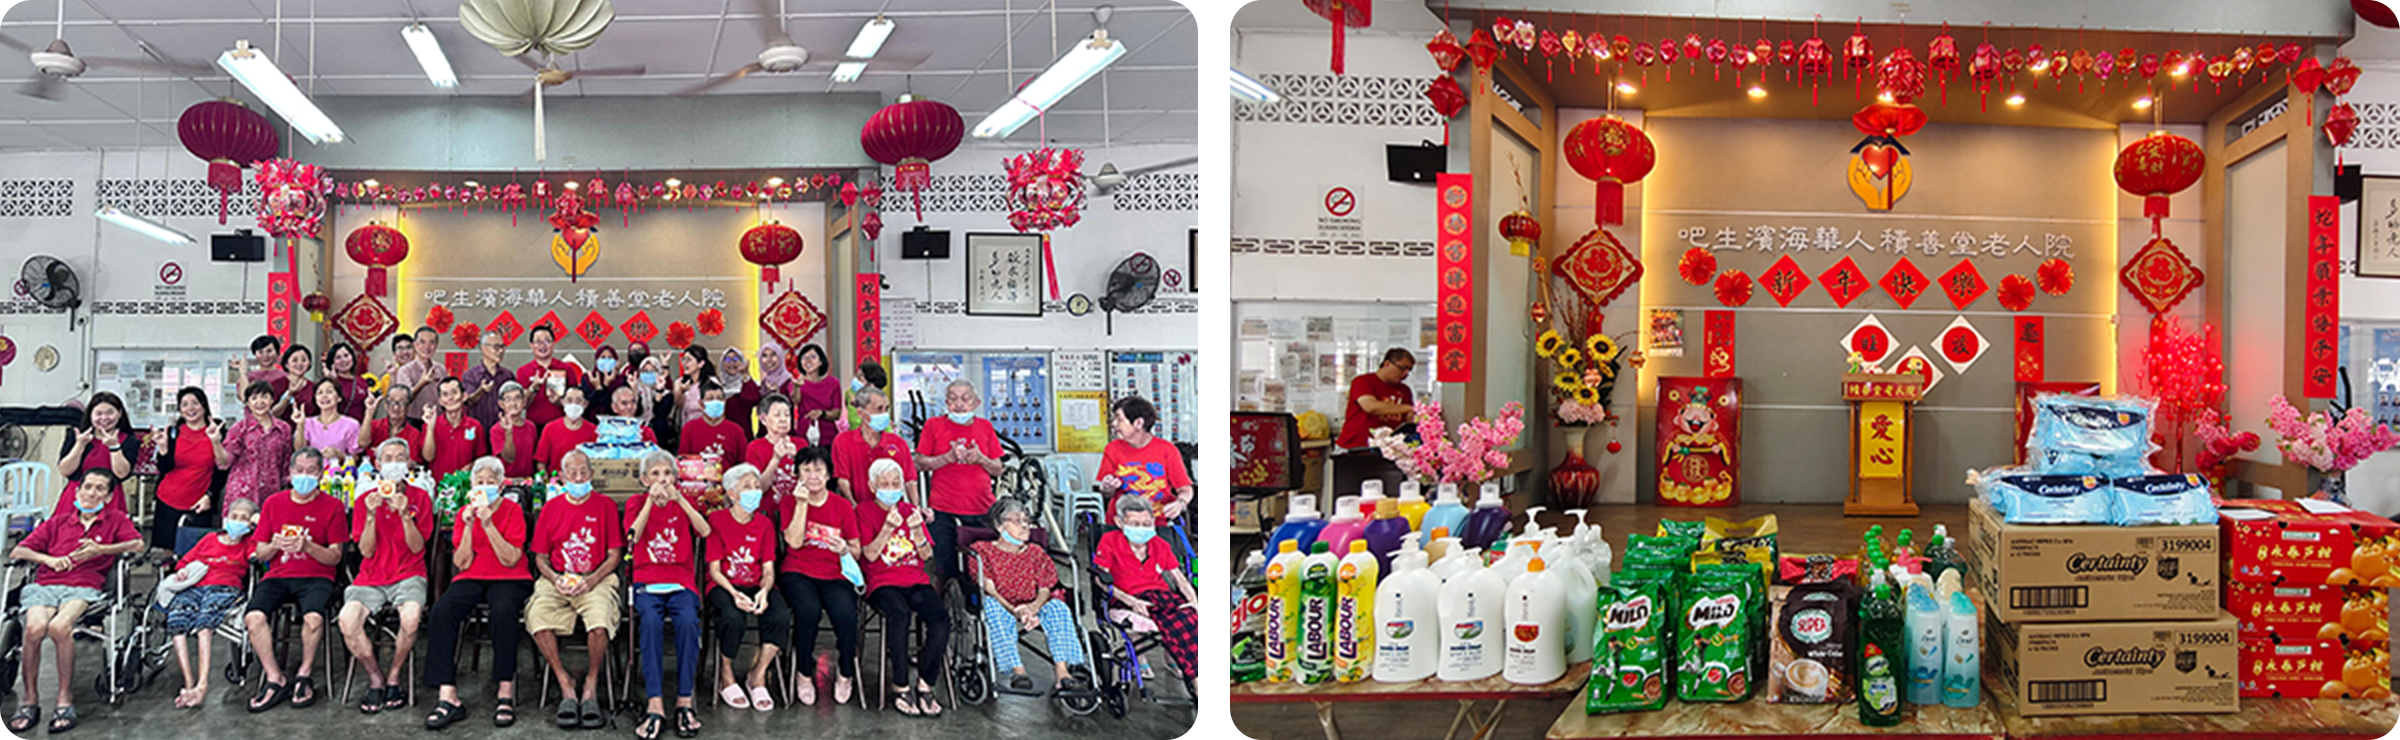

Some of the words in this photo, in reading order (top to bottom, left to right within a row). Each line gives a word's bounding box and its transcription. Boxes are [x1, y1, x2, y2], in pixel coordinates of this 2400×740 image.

[1678, 225, 2075, 259] 吧生濱海華人積善堂老人院
[1770, 266, 1979, 297] 新年快樂
[2162, 540, 2211, 551] 3199004
[2066, 552, 2149, 575] Certainty
[1693, 604, 1735, 621] MILO
[1268, 597, 1285, 660] LABOUR
[1307, 598, 1328, 660] LABOUR
[1339, 597, 1357, 660] LABOUR
[1797, 617, 1827, 633] SUPER
[2179, 633, 2229, 645] 3199004
[2084, 645, 2166, 669] Certainty
